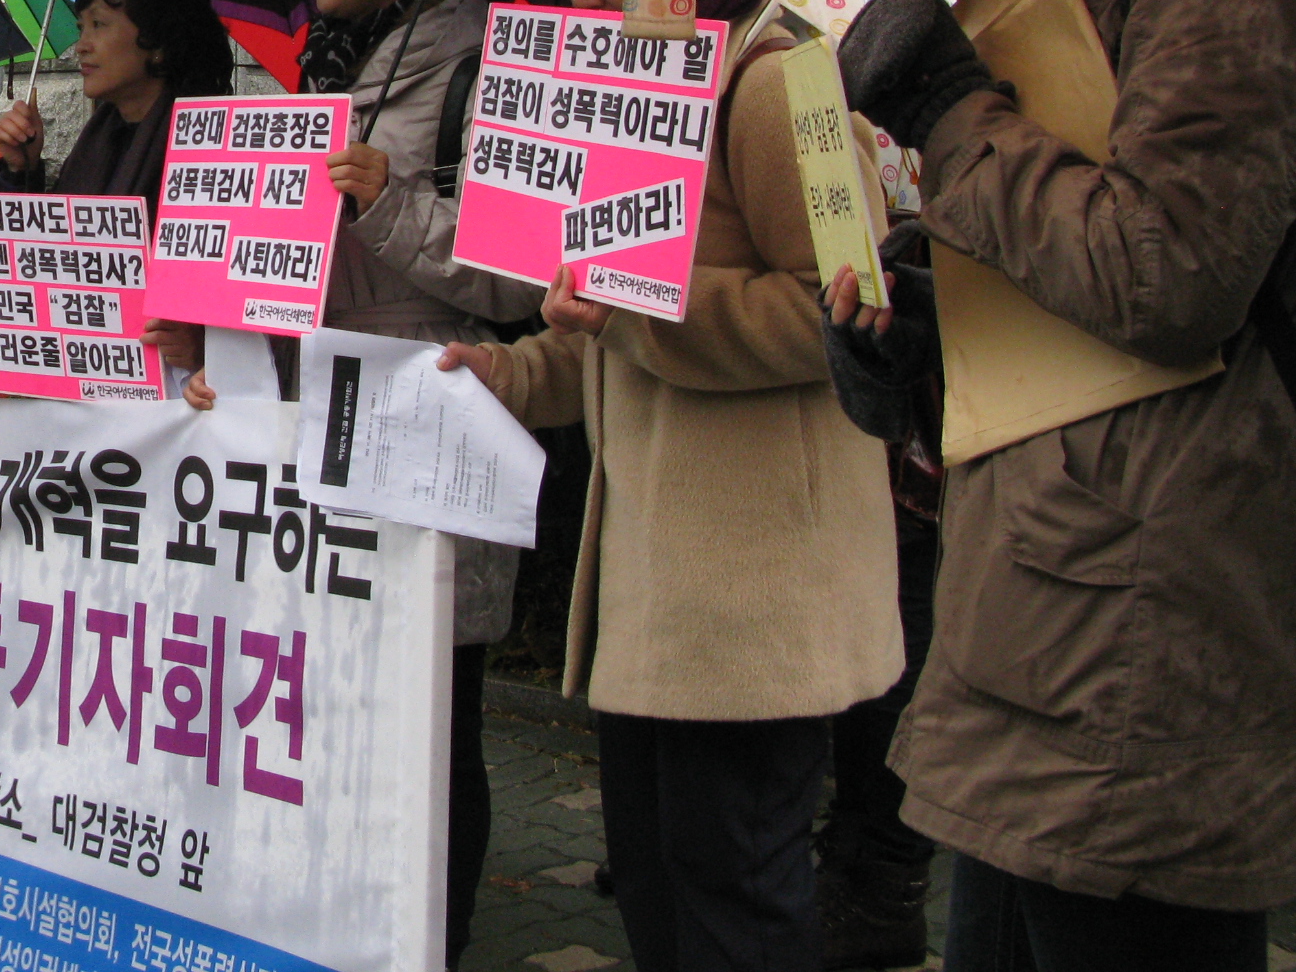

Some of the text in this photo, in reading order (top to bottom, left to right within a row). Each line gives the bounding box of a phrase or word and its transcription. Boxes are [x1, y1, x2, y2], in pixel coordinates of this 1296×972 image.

[492, 15, 556, 62] 정의를
[564, 23, 669, 77] 수호해야
[174, 109, 330, 149] 한상대 검찰총장은
[481, 74, 710, 152] 검찰이 성폭력이라니
[473, 133, 583, 197] 성폭력검사
[167, 167, 308, 205] 성폭력검사 사건
[73, 205, 142, 240] 모자라
[564, 183, 683, 253] 파면하라!
[159, 222, 227, 259] 책임지고
[17, 247, 143, 288] 성폭력검사?
[230, 240, 322, 282] 사퇴하라!
[608, 271, 682, 305] 한국여성단체연합
[259, 304, 315, 325] 한국여성단체연합
[66, 341, 144, 378] 알아라!
[97, 384, 159, 401] 한국여성단체연합
[166, 455, 379, 601] 요구하는
[52, 794, 168, 878] 대검찰청
[178, 828, 210, 894] 앞
